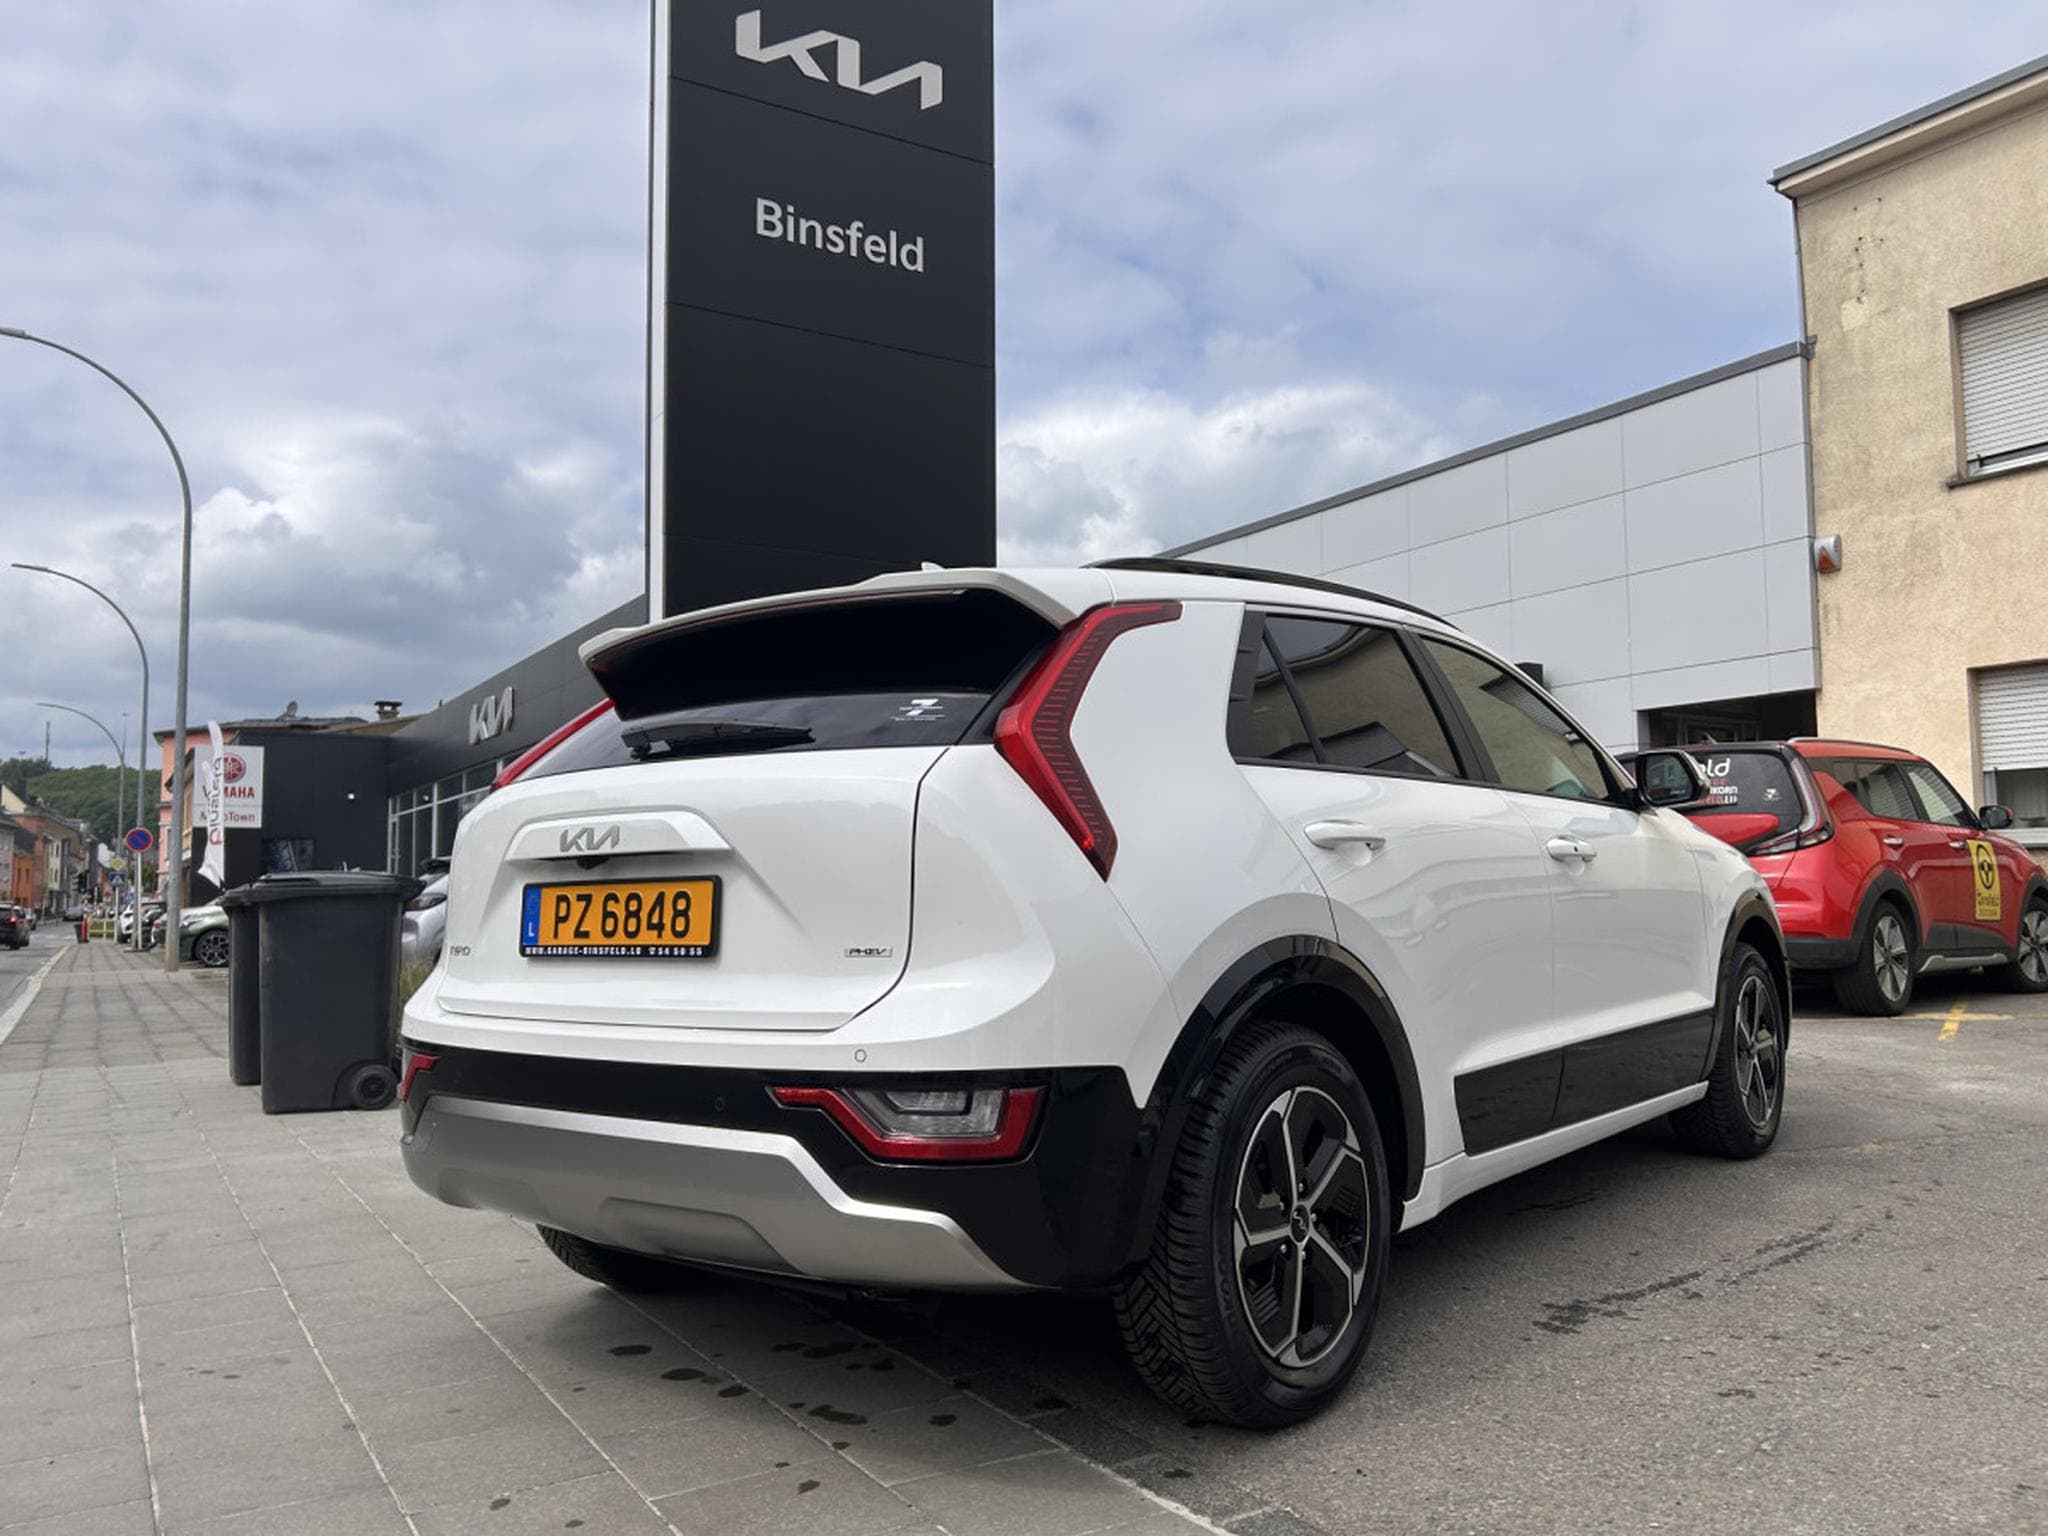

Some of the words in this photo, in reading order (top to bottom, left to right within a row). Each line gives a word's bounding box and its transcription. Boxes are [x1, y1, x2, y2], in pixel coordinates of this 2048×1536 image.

[756, 197, 925, 273] Binsfeld
[553, 893, 593, 940] PZ
[600, 890, 692, 940] 6848
